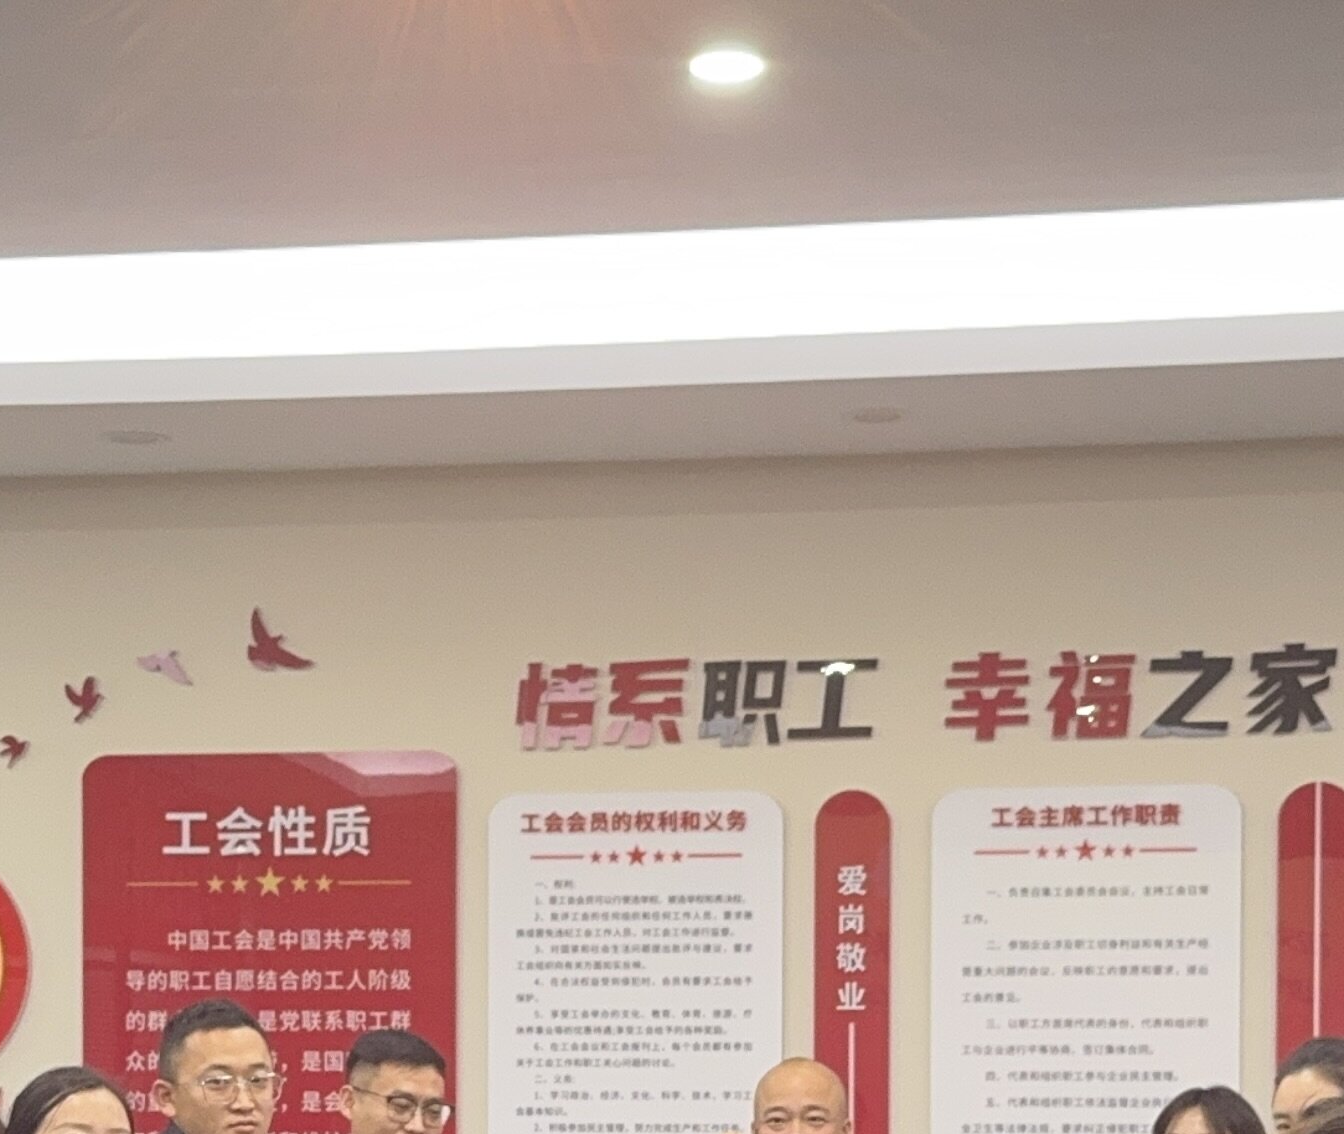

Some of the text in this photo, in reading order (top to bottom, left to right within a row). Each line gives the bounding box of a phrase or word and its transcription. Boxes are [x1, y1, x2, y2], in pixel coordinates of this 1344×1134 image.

[514, 642, 1339, 752] 情系职工 幸福之家
[520, 810, 748, 834] 工会会员的权利和义务
[991, 804, 1181, 828] 工会主席工作职责
[161, 805, 372, 858] 工会性质
[167, 928, 412, 952] 中国工会是中国共产党领
[835, 864, 867, 1011] 爱岗敬业
[125, 969, 412, 992] 导的职工自愿结合的工人阶级
